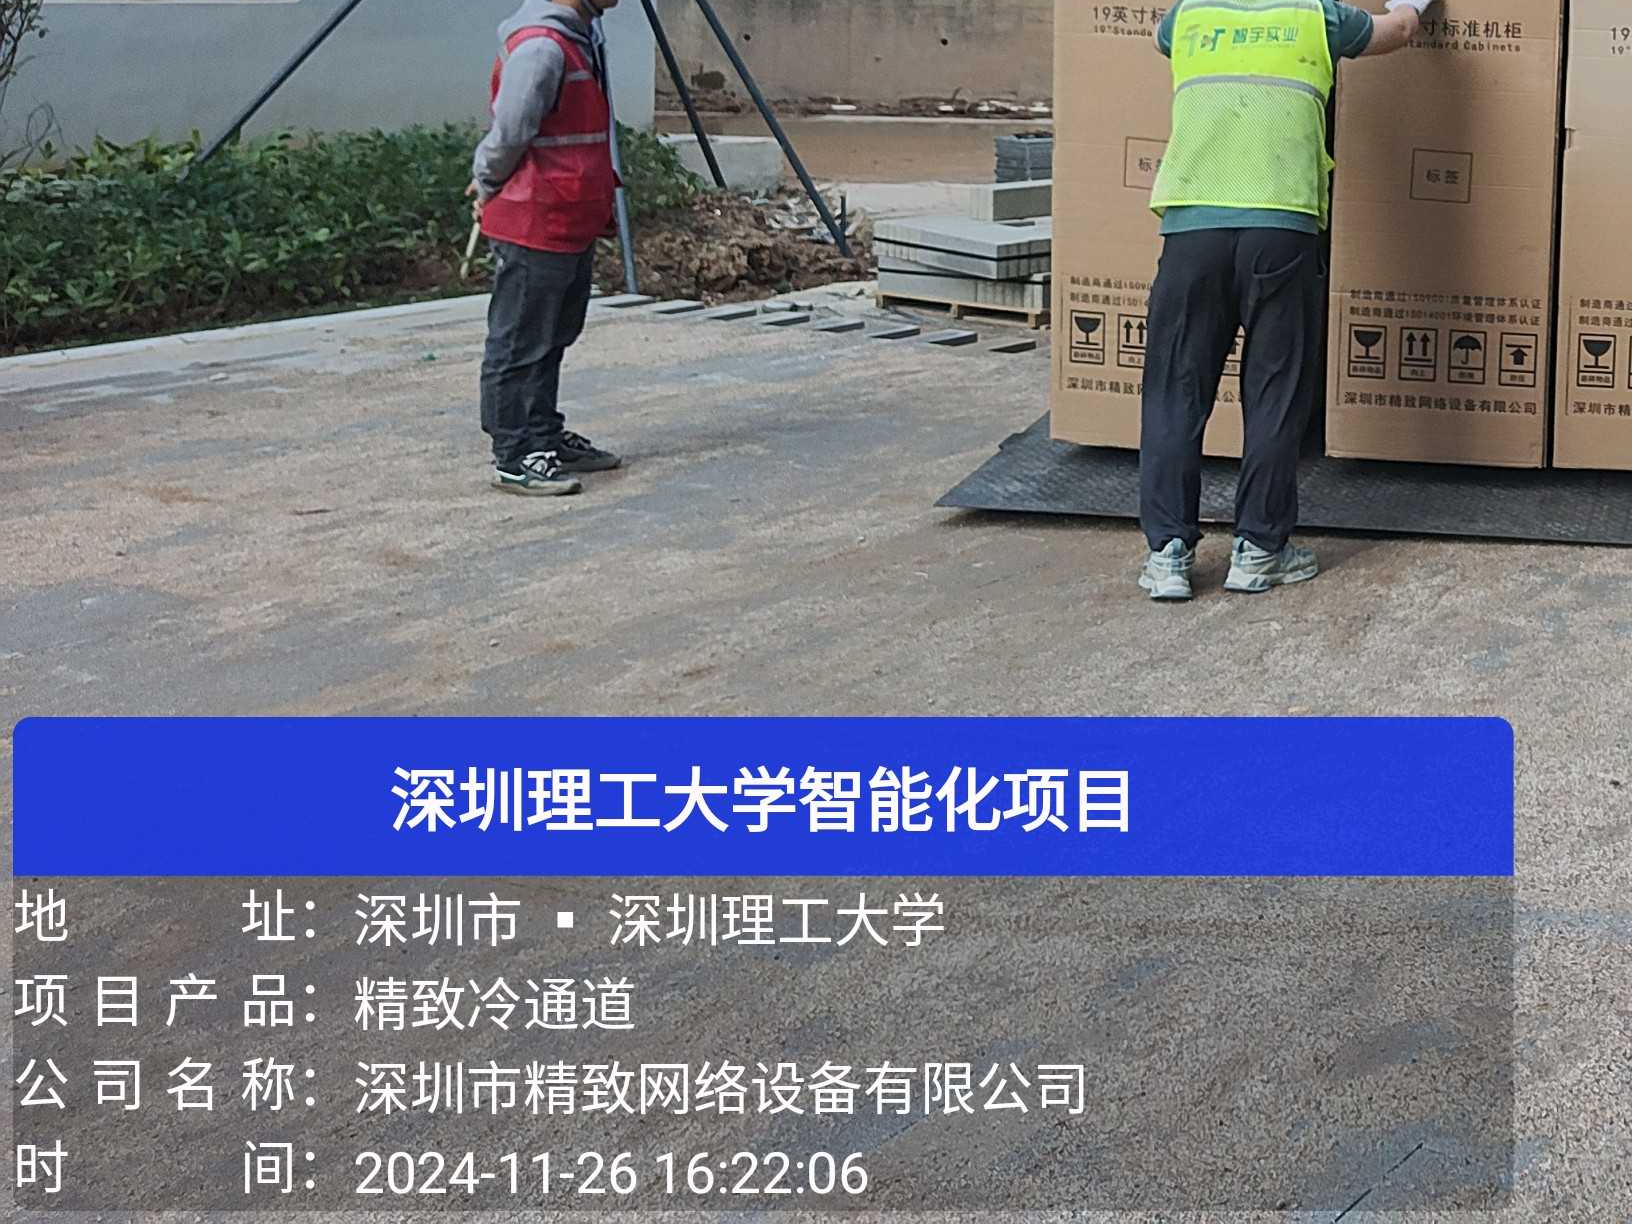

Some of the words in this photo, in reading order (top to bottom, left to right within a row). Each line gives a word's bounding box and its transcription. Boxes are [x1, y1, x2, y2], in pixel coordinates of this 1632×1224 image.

[1425, 168, 1460, 185] 标签
[1344, 391, 1537, 416] 深圳市精致网络设备有限公司
